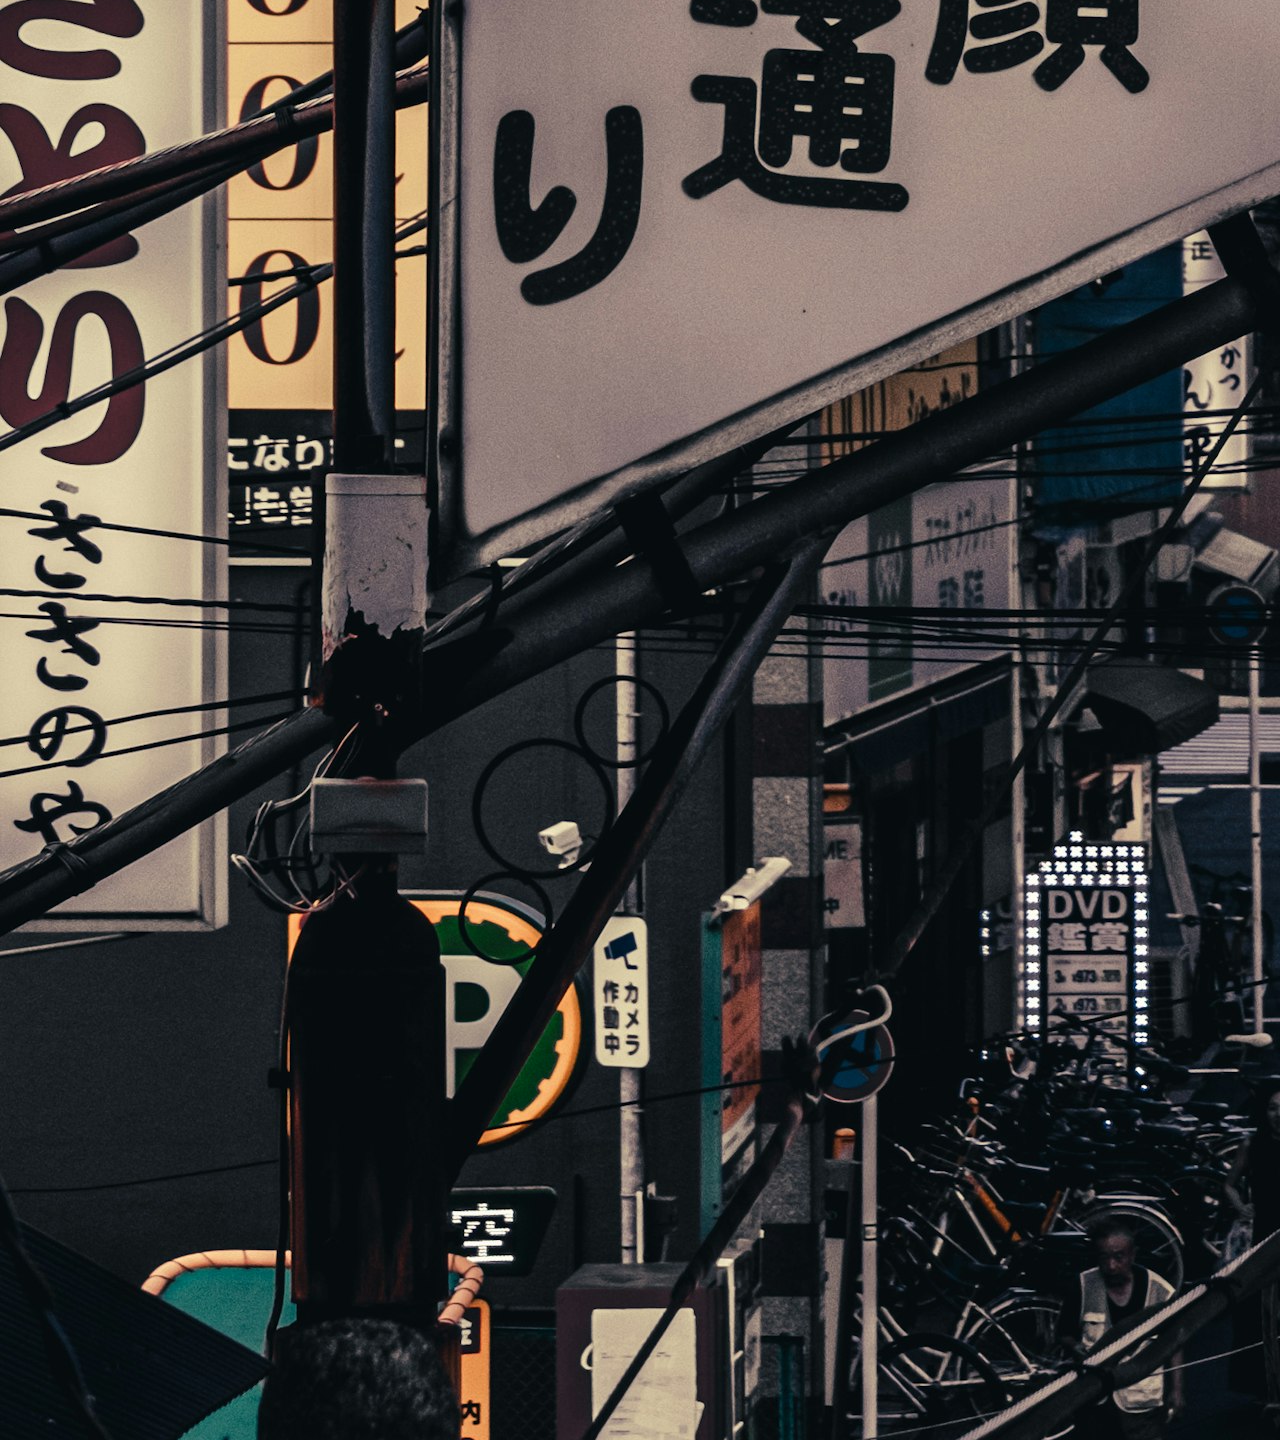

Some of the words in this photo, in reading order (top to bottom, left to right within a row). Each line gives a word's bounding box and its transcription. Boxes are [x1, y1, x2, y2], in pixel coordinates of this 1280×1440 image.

[1047, 889, 1128, 920] DVD
[603, 980, 622, 1056] 作動中
[623, 983, 641, 1057] カメラ
